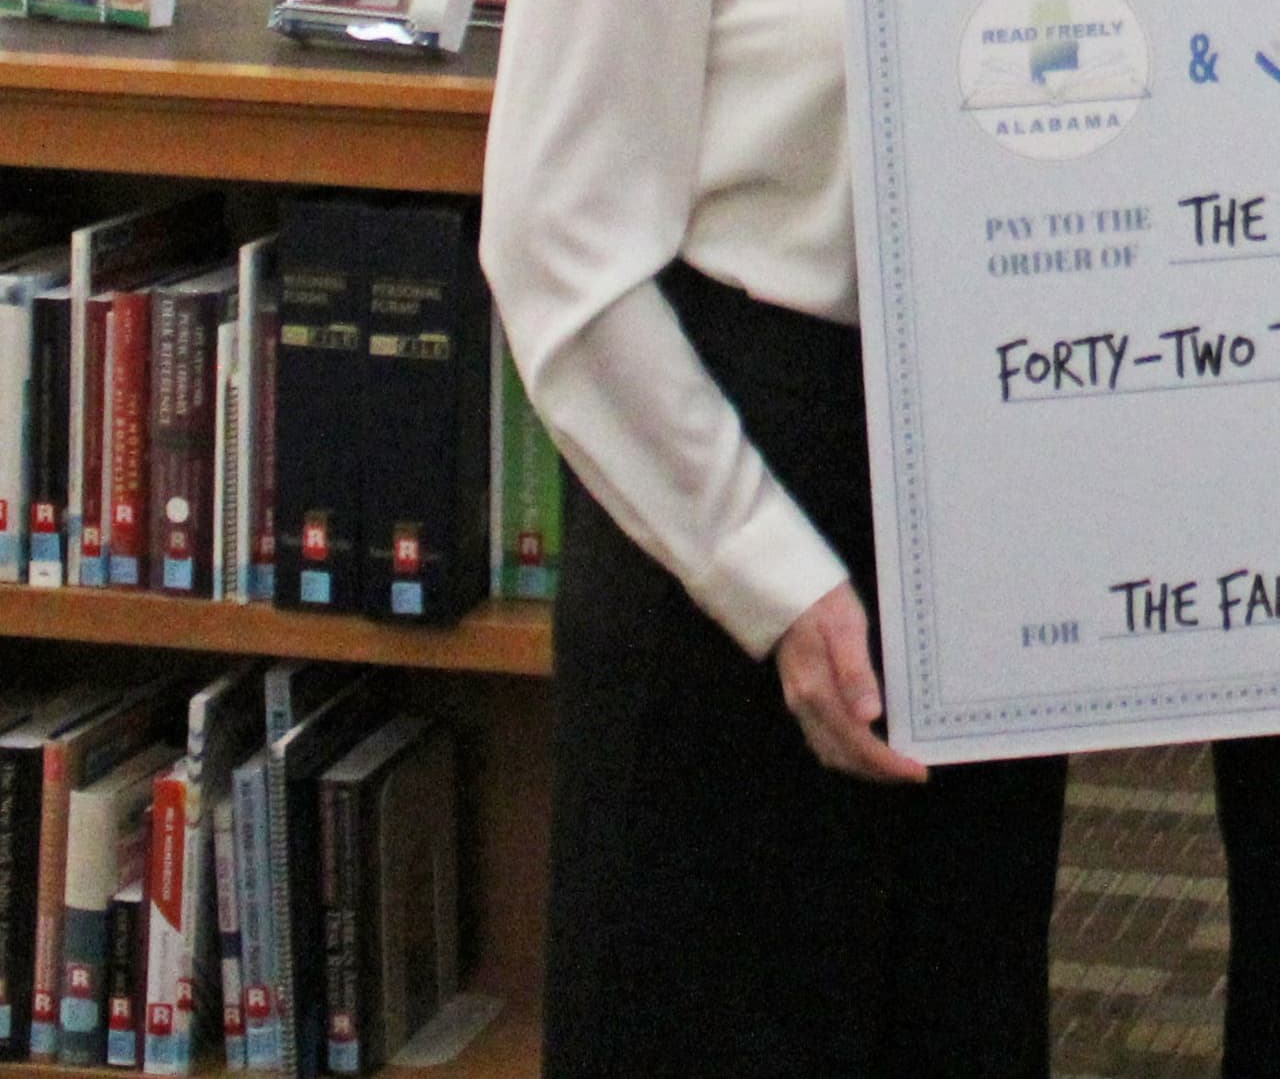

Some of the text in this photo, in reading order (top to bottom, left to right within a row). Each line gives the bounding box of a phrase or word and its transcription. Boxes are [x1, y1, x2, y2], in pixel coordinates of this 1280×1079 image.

[982, 20, 1124, 45] READ FREELY
[1189, 33, 1219, 83] &
[996, 113, 1120, 136] ALABAMA
[986, 206, 1152, 241] PAY TO THE
[1178, 192, 1268, 246] THE
[987, 242, 1138, 277] ORDER OF
[995, 325, 1257, 403] FORTY-TWO
[1109, 578, 1199, 635] THE
[1020, 621, 1080, 648] FOR
